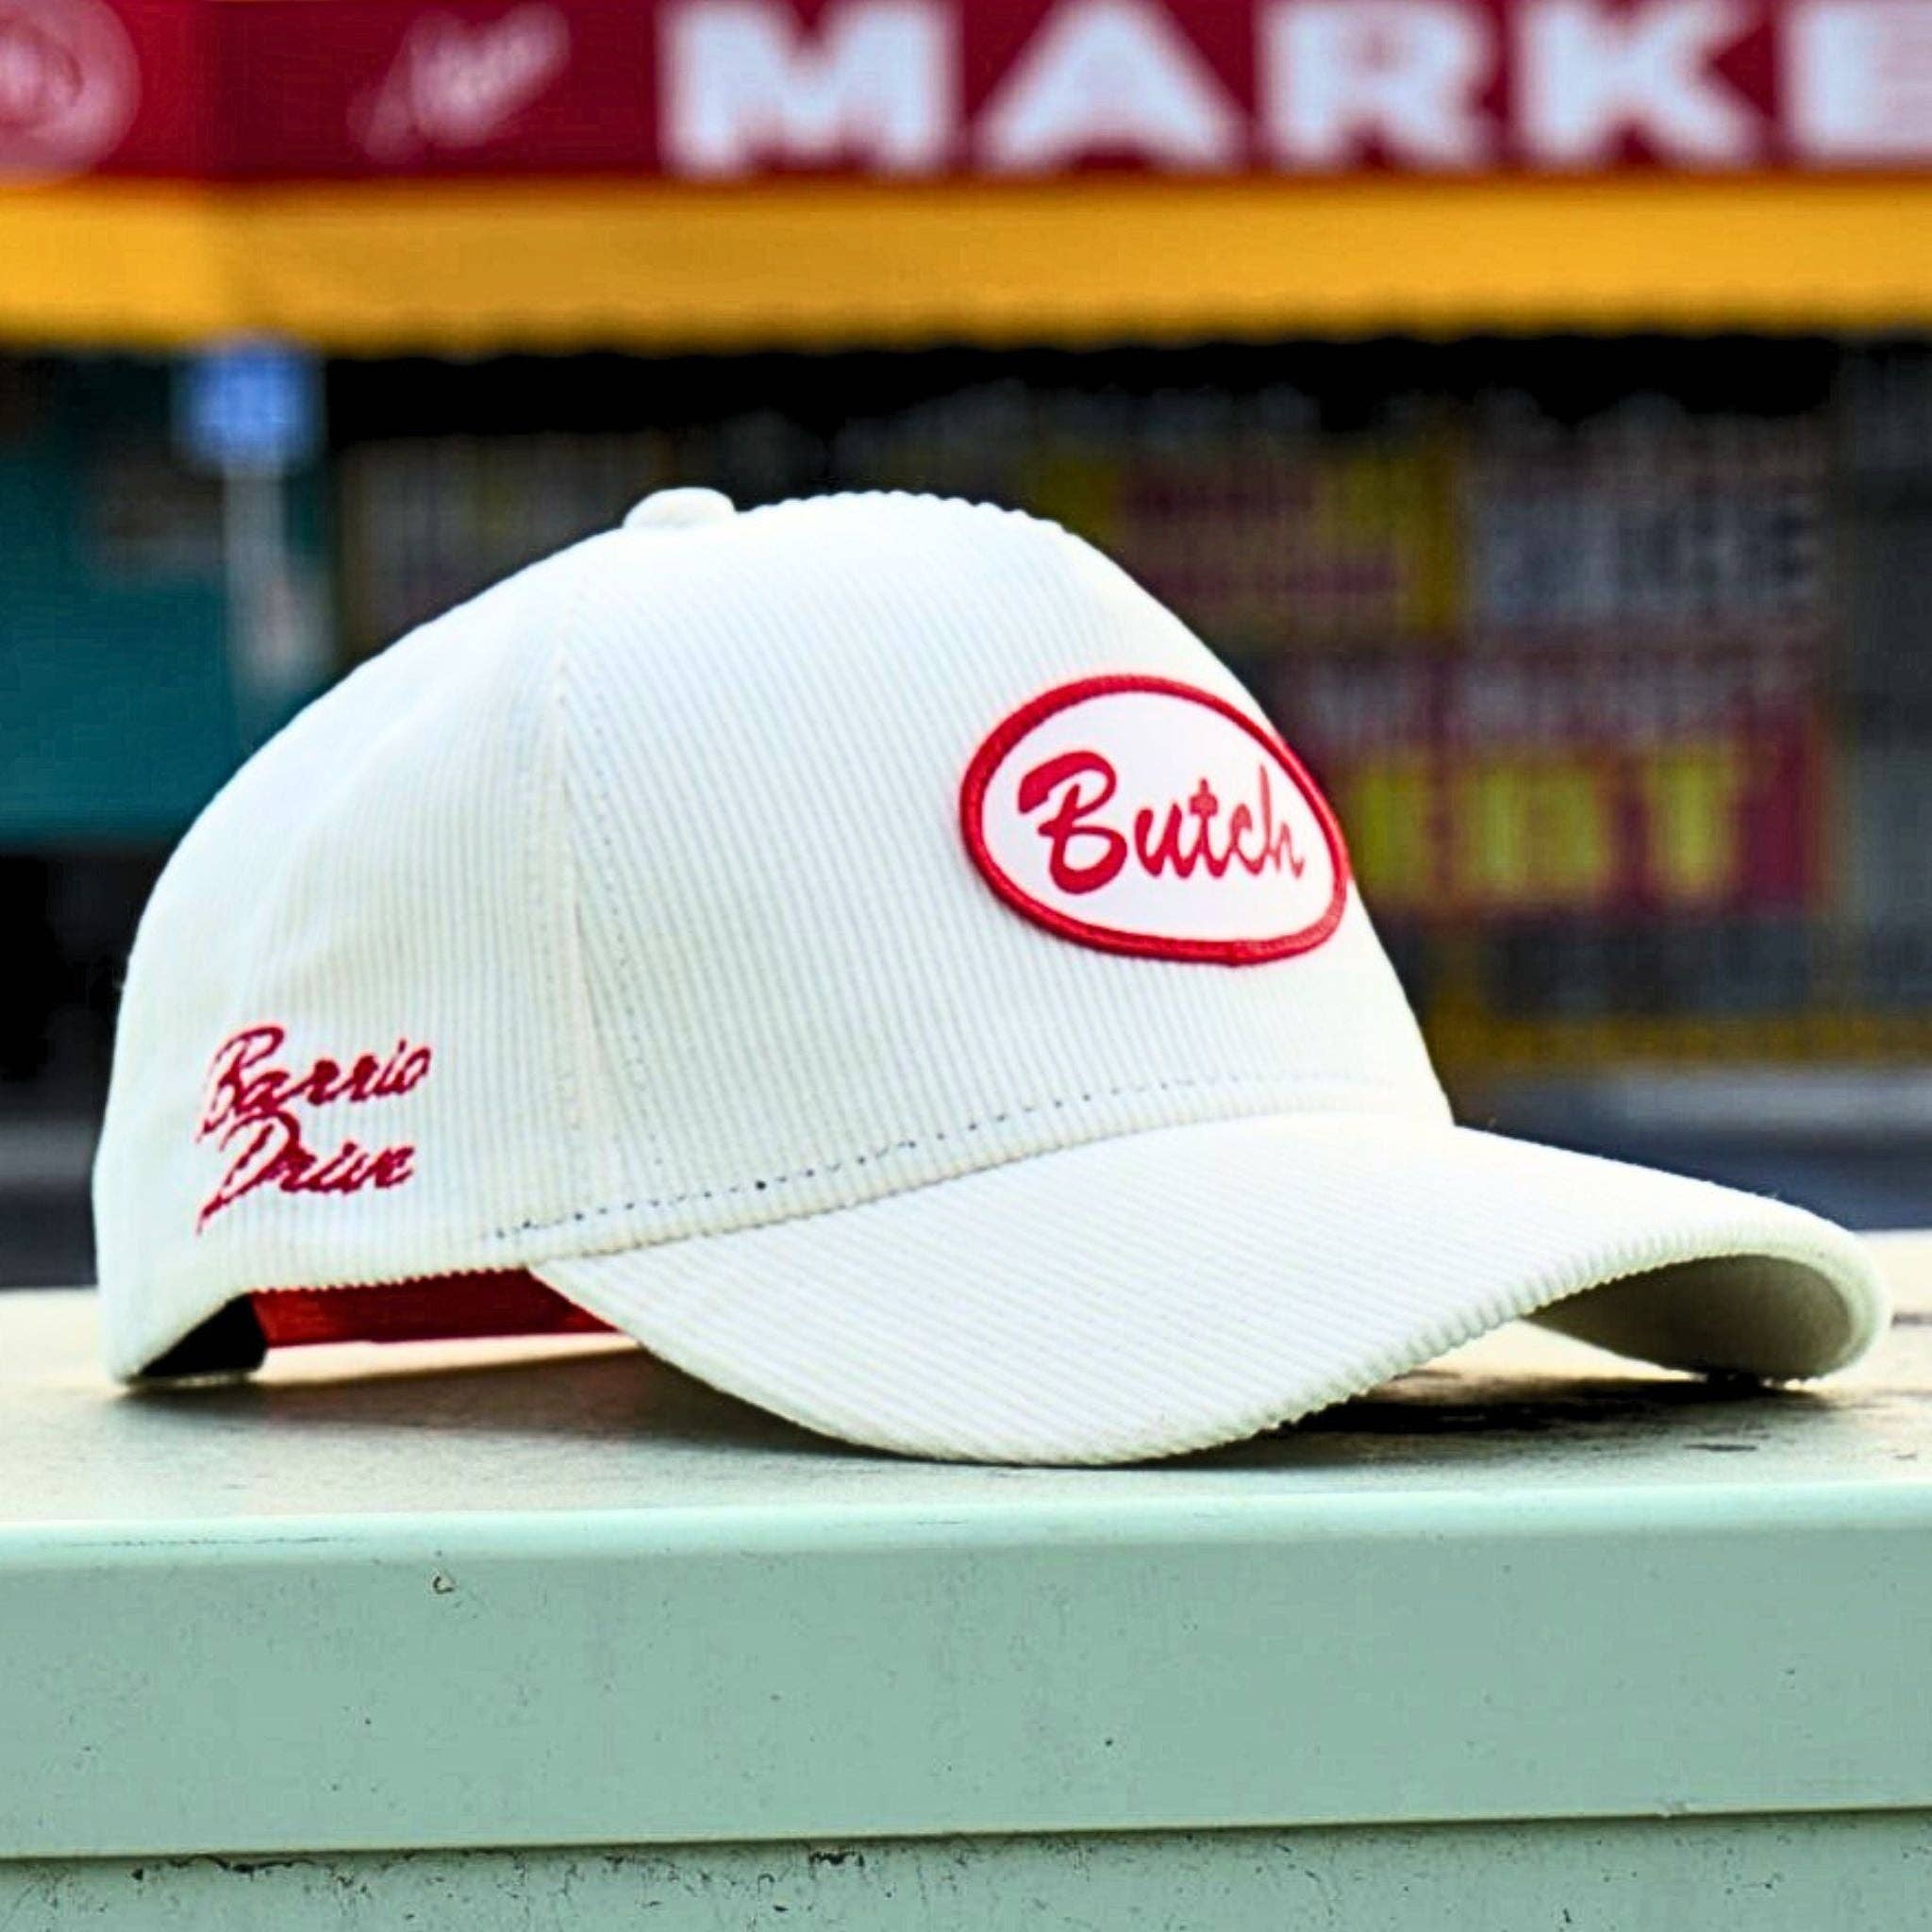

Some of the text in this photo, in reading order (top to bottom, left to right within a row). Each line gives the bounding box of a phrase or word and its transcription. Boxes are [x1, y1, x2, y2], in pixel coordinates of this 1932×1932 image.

[1016, 749, 1305, 895] Butch
[197, 1024, 432, 1140] Barrio
[197, 1110, 415, 1233] Drive
